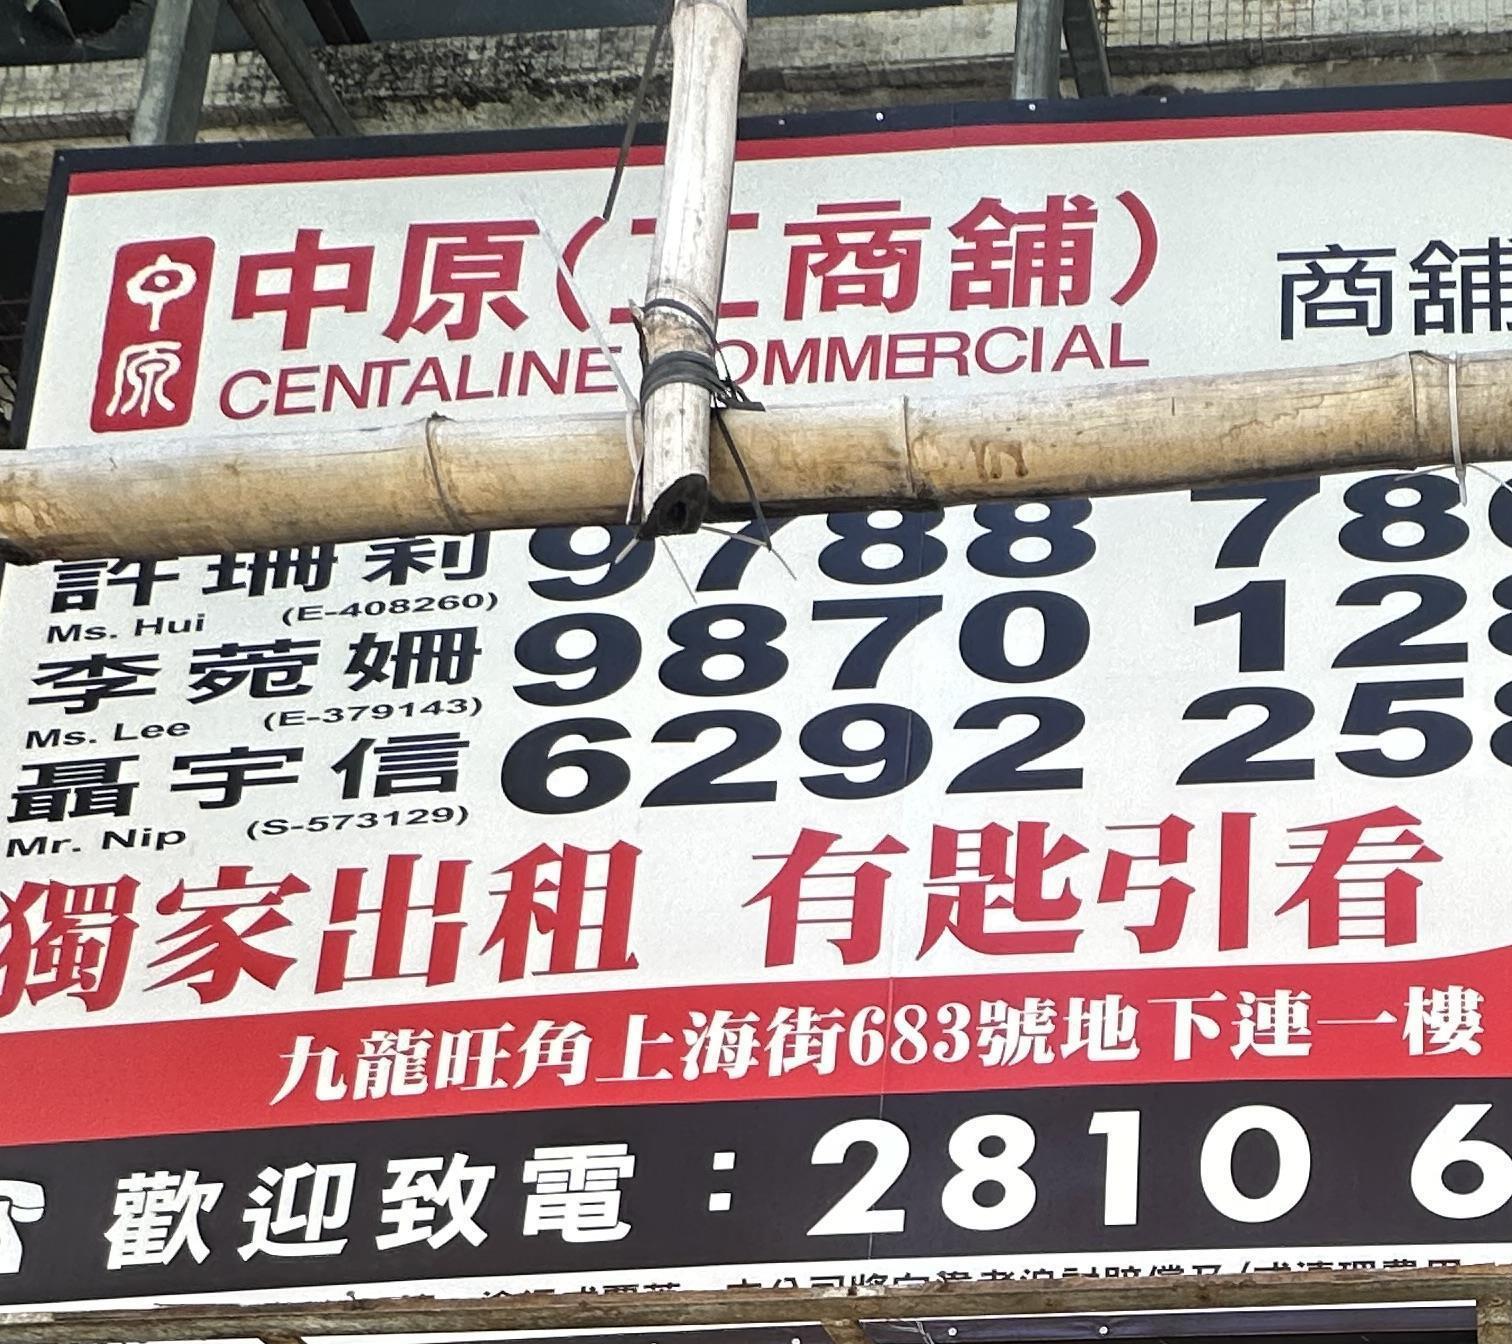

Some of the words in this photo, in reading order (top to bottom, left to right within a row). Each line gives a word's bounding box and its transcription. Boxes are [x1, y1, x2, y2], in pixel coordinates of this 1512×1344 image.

[219, 345, 622, 421] CENTALINE
[712, 322, 1149, 388] OMMERCIAL
[528, 498, 1096, 601] 9788
[47, 625, 118, 643] Ms.
[135, 613, 205, 637] Hui
[282, 592, 498, 626] (E-408260)
[513, 590, 1090, 707] 9870
[26, 729, 97, 749] Ms.
[114, 721, 191, 741] Lee
[264, 697, 483, 731] (E-379143)
[500, 696, 1086, 815] 6292
[7, 732, 470, 823] 聶宇信
[6, 837, 81, 857] Mr.
[101, 827, 187, 850] Nip
[246, 805, 469, 840] (S-573129)
[0, 839, 645, 1015] 獨家出租
[741, 804, 1443, 969] 有匙引看
[270, 986, 1485, 1106] 九龍旺角上海街683號地下連一樓
[806, 1104, 1311, 1236] 2810
